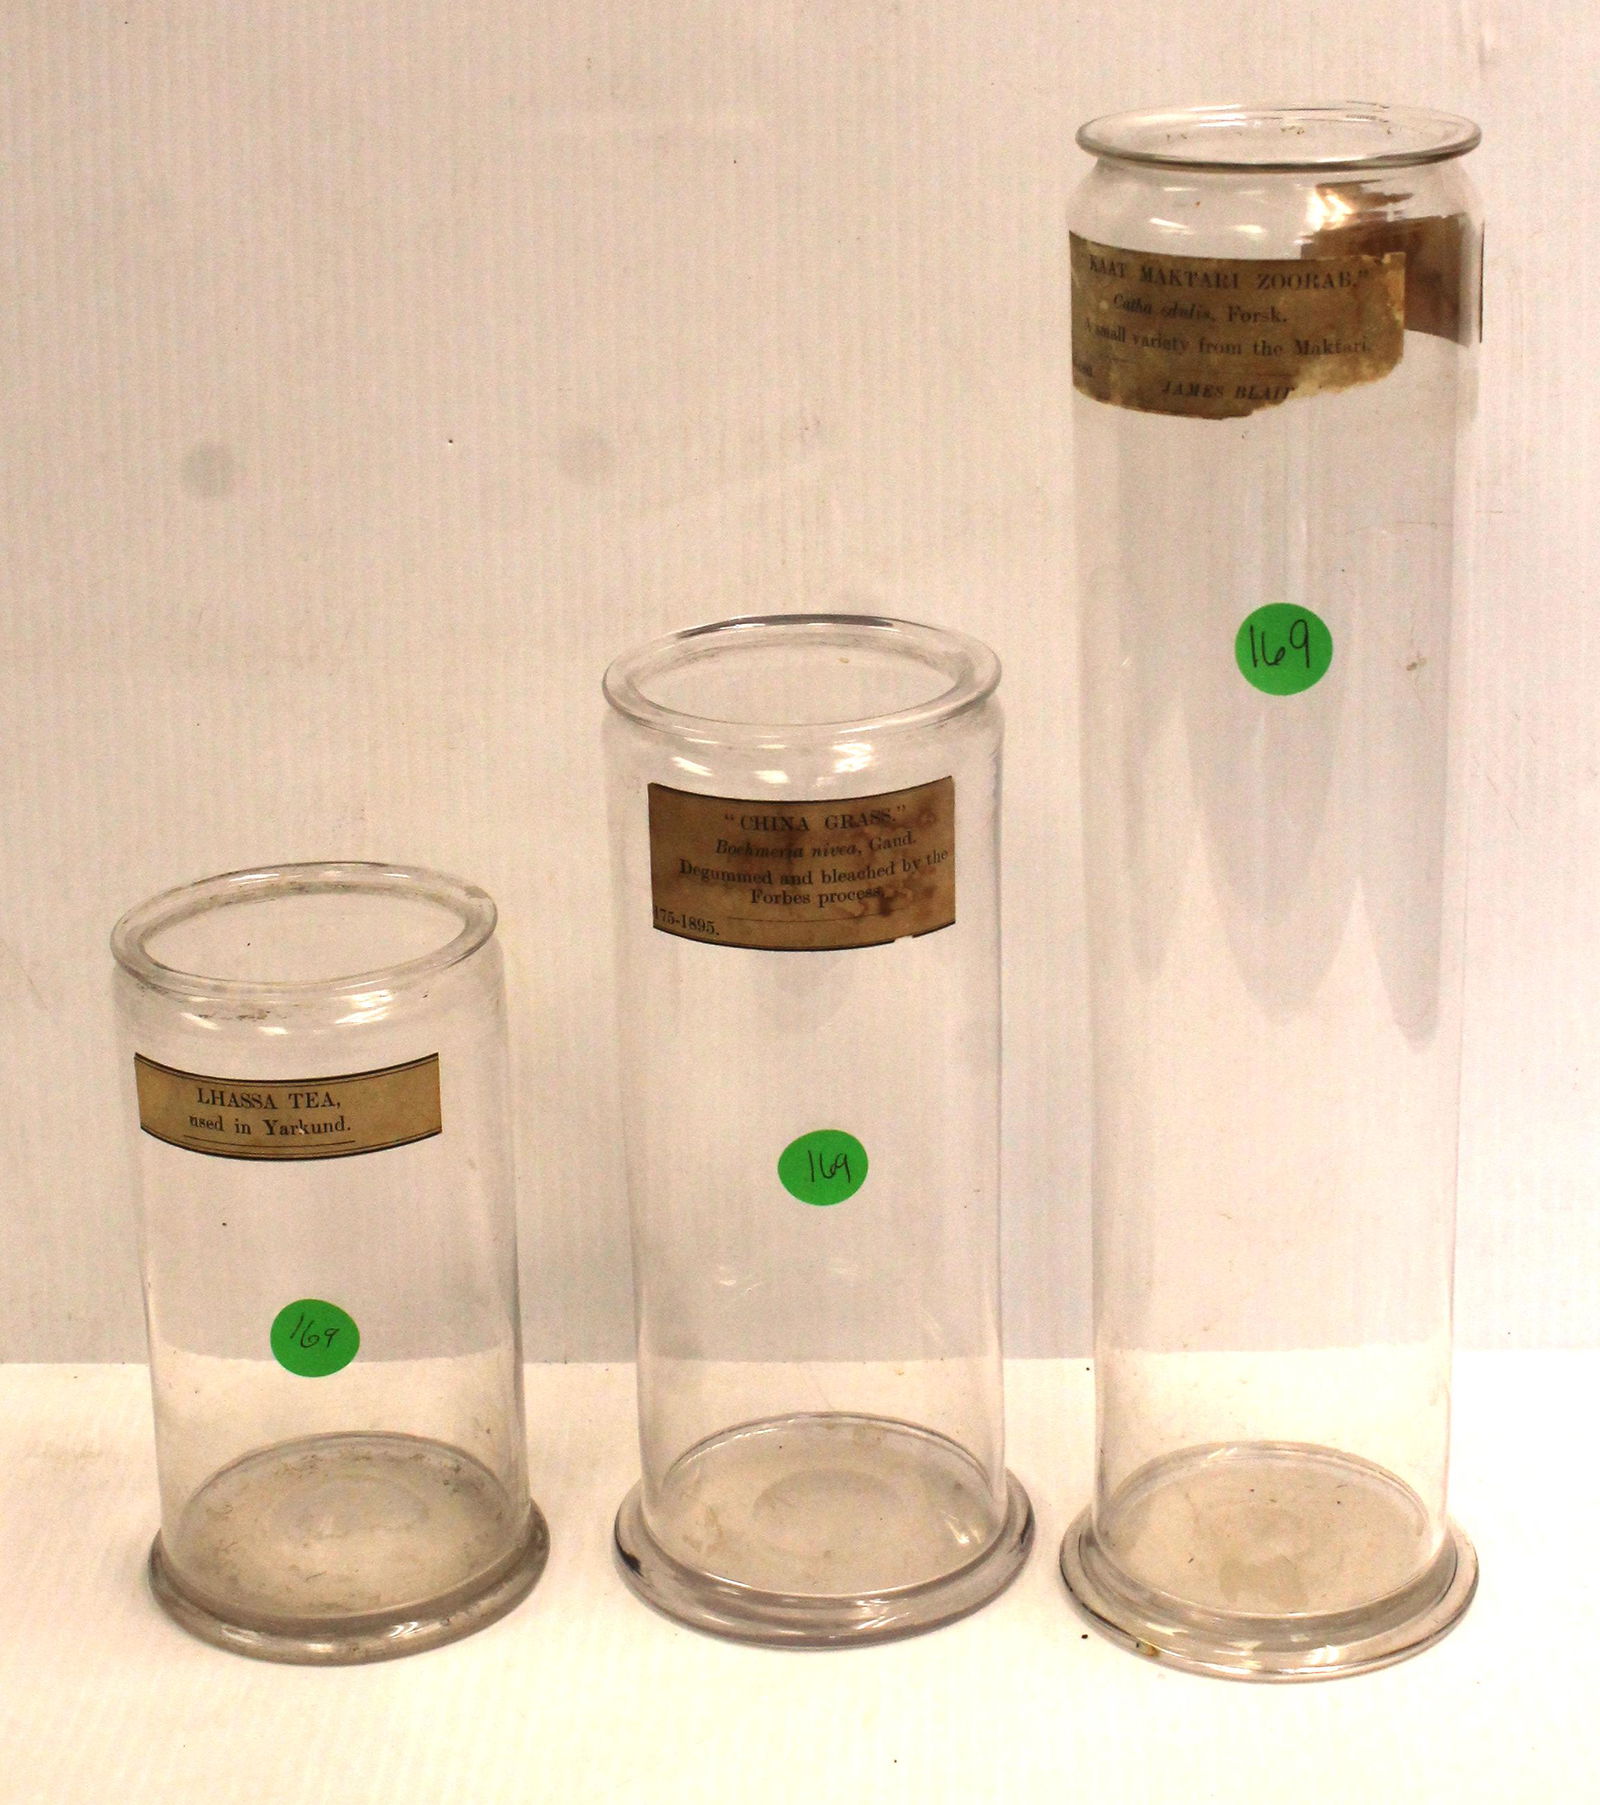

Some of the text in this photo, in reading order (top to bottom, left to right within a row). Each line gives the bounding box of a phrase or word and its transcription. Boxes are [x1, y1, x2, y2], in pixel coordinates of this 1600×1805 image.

[1140, 264, 1240, 290] MAKTARI
[1228, 305, 1287, 323] Forsk.
[1133, 330, 1190, 355] variety
[1200, 336, 1243, 355] from
[1252, 340, 1284, 357] the
[1160, 381, 1224, 399] JAMES
[1249, 618, 1311, 669] 169
[679, 848, 949, 886] Degummed and bleached by the
[751, 888, 812, 905] Forbes
[197, 1087, 341, 1110] LHASSA TEA,
[188, 1114, 225, 1133] used
[235, 1117, 251, 1134] in
[806, 1149, 851, 1184] 169
